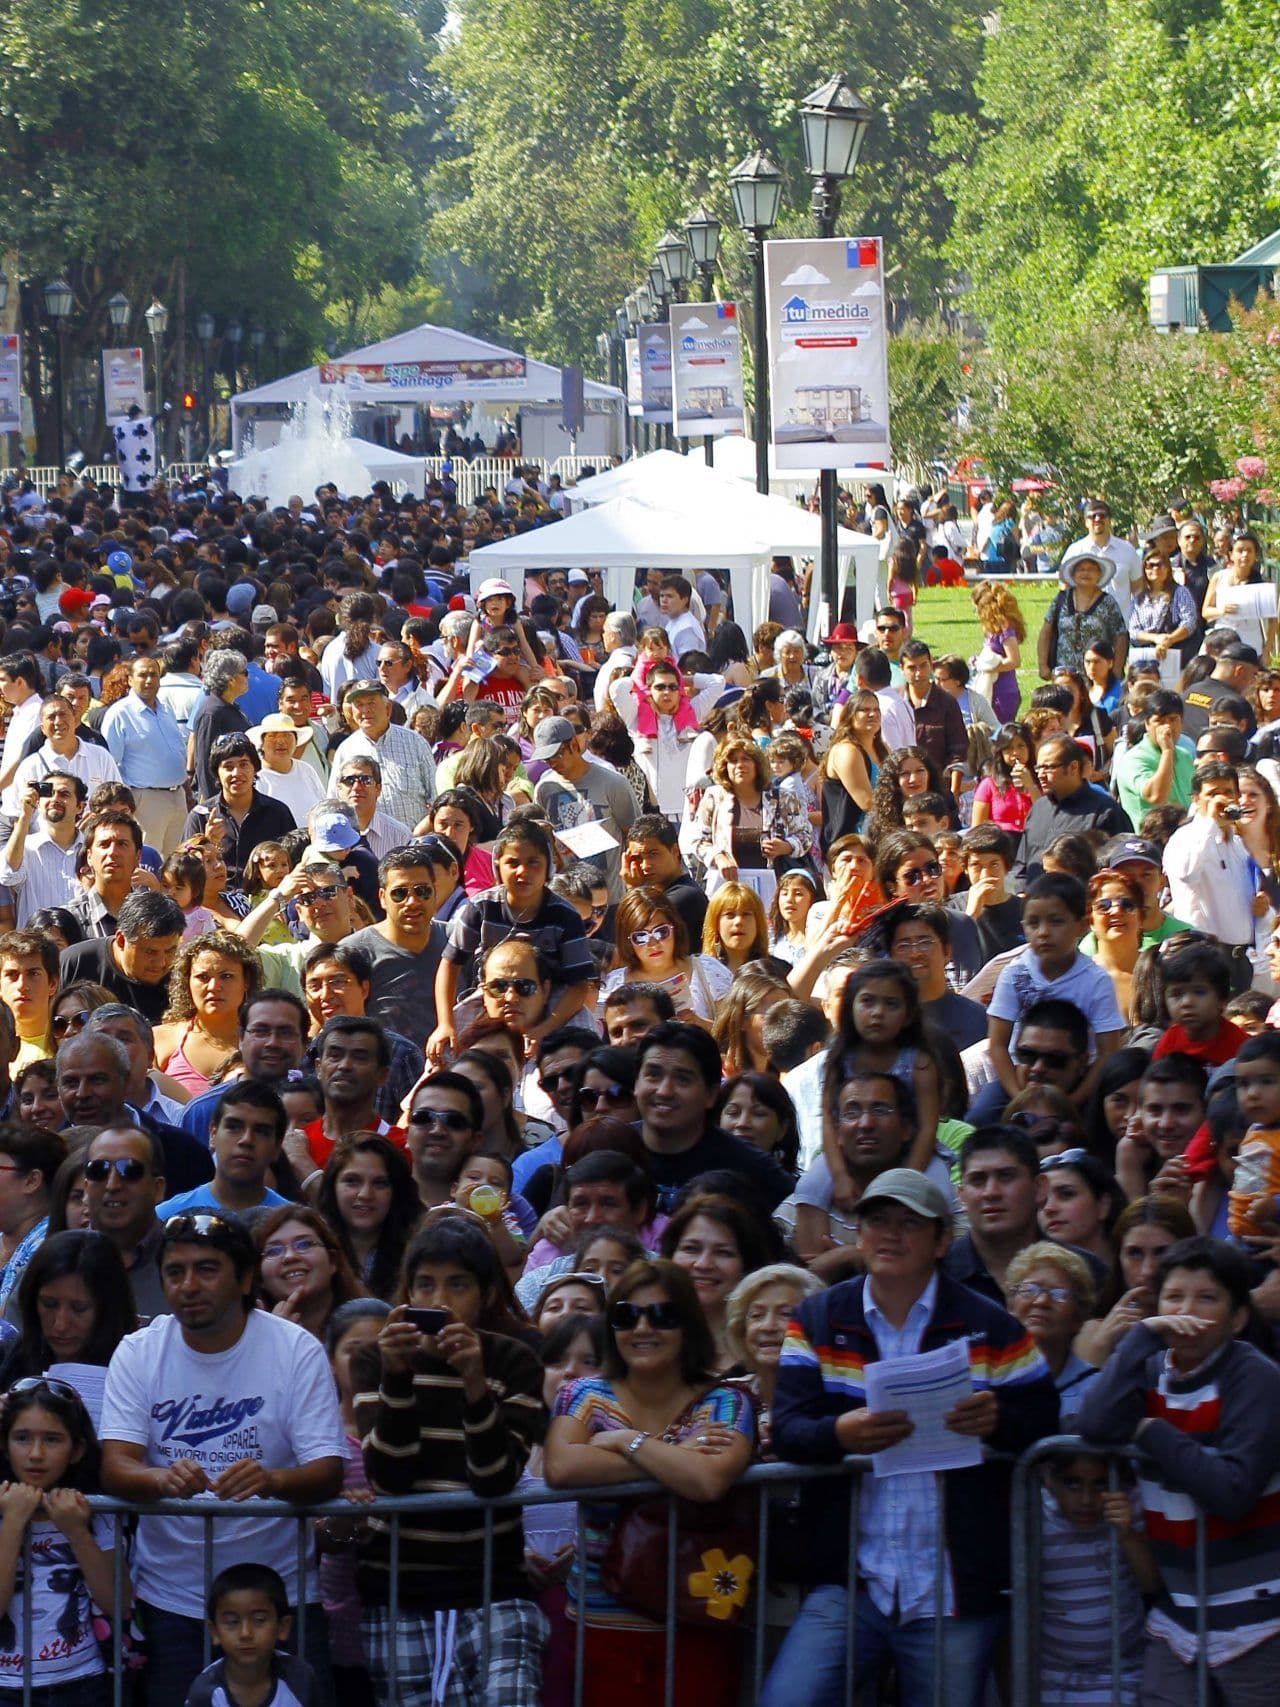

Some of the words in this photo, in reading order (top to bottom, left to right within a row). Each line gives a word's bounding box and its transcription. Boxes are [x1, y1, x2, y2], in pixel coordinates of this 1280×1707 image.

[788, 307, 805, 320] tu
[812, 303, 868, 318] medida
[384, 365, 419, 378] Expo
[391, 373, 453, 388] Santiago
[151, 1394, 264, 1447] Vintage
[223, 1426, 260, 1449] APPAREL
